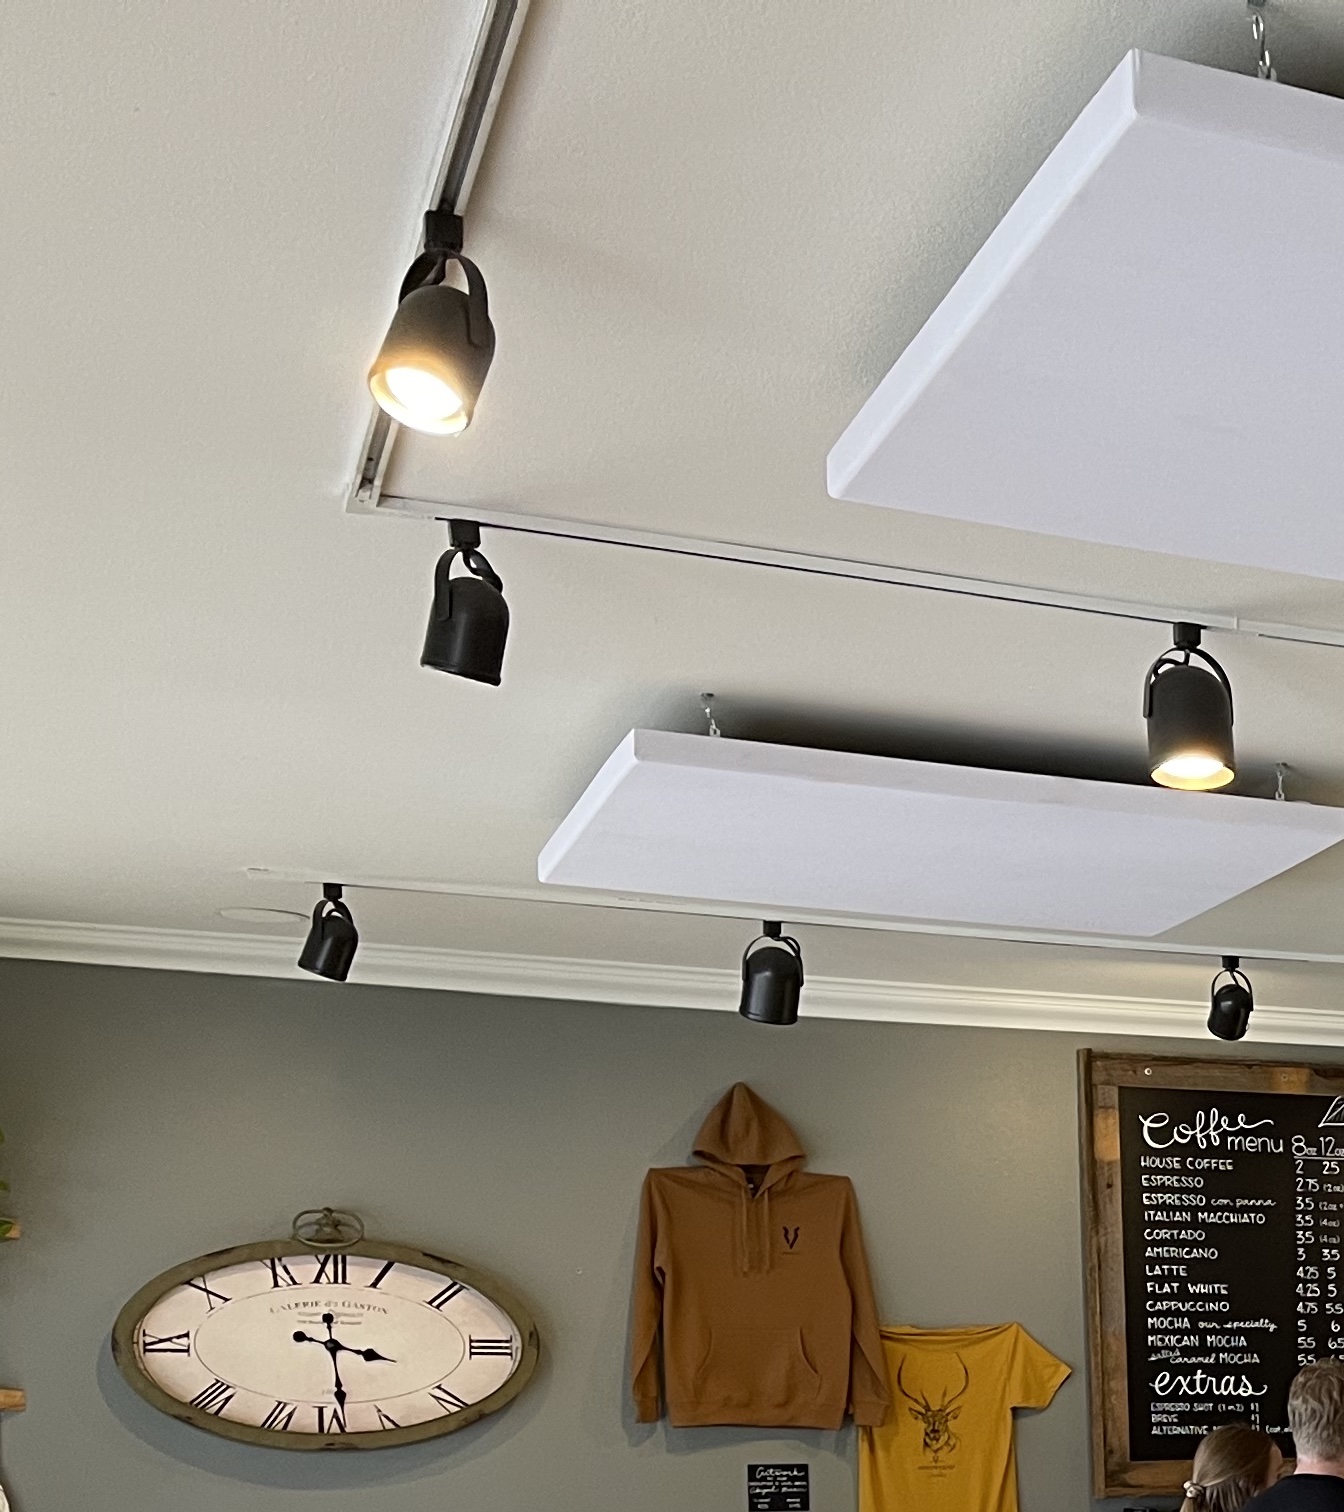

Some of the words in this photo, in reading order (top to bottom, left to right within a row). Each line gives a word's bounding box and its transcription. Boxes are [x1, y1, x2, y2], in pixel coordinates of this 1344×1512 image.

[1139, 1108, 1274, 1149] Coffee
[1228, 1136, 1283, 1152] menu
[1141, 1156, 1181, 1168] HOUSE
[1187, 1158, 1233, 1170] COFFEE
[1296, 1160, 1303, 1174] 2
[1142, 1175, 1203, 1187] ESPRESSO
[1143, 1193, 1205, 1206] ESPRESSO
[1236, 1199, 1276, 1207] panna
[1145, 1211, 1190, 1221] ITALIAN
[1198, 1212, 1265, 1224] MACCHIATO
[1144, 1229, 1205, 1240] CORTADO
[1145, 1247, 1218, 1259] AMERICANO
[1297, 1248, 1305, 1260] 3
[309, 1254, 351, 1286] XII
[1146, 1265, 1187, 1276] LATTE
[1328, 1267, 1336, 1279] 5
[181, 1274, 233, 1315] X
[422, 1280, 470, 1313] II
[1147, 1282, 1179, 1293] FLAT
[1188, 1283, 1228, 1294] WHITE
[1328, 1284, 1337, 1297] 5
[1146, 1301, 1229, 1311] CAPPUCCINO
[1148, 1317, 1190, 1329] MOCHA
[1223, 1319, 1277, 1332] specialty
[1298, 1320, 1306, 1331] 5
[1331, 1321, 1340, 1332] 6
[469, 1334, 513, 1361] III
[1148, 1335, 1198, 1347] MEXICAN
[1207, 1335, 1247, 1347] MOCHA
[1170, 1353, 1215, 1363] caramel
[1220, 1353, 1259, 1364] MOCHA
[1149, 1370, 1267, 1396] extras
[1151, 1403, 1190, 1411] ESPRESSO
[1193, 1403, 1213, 1411] SHOT
[1152, 1426, 1208, 1434] ALTERNATIVE
